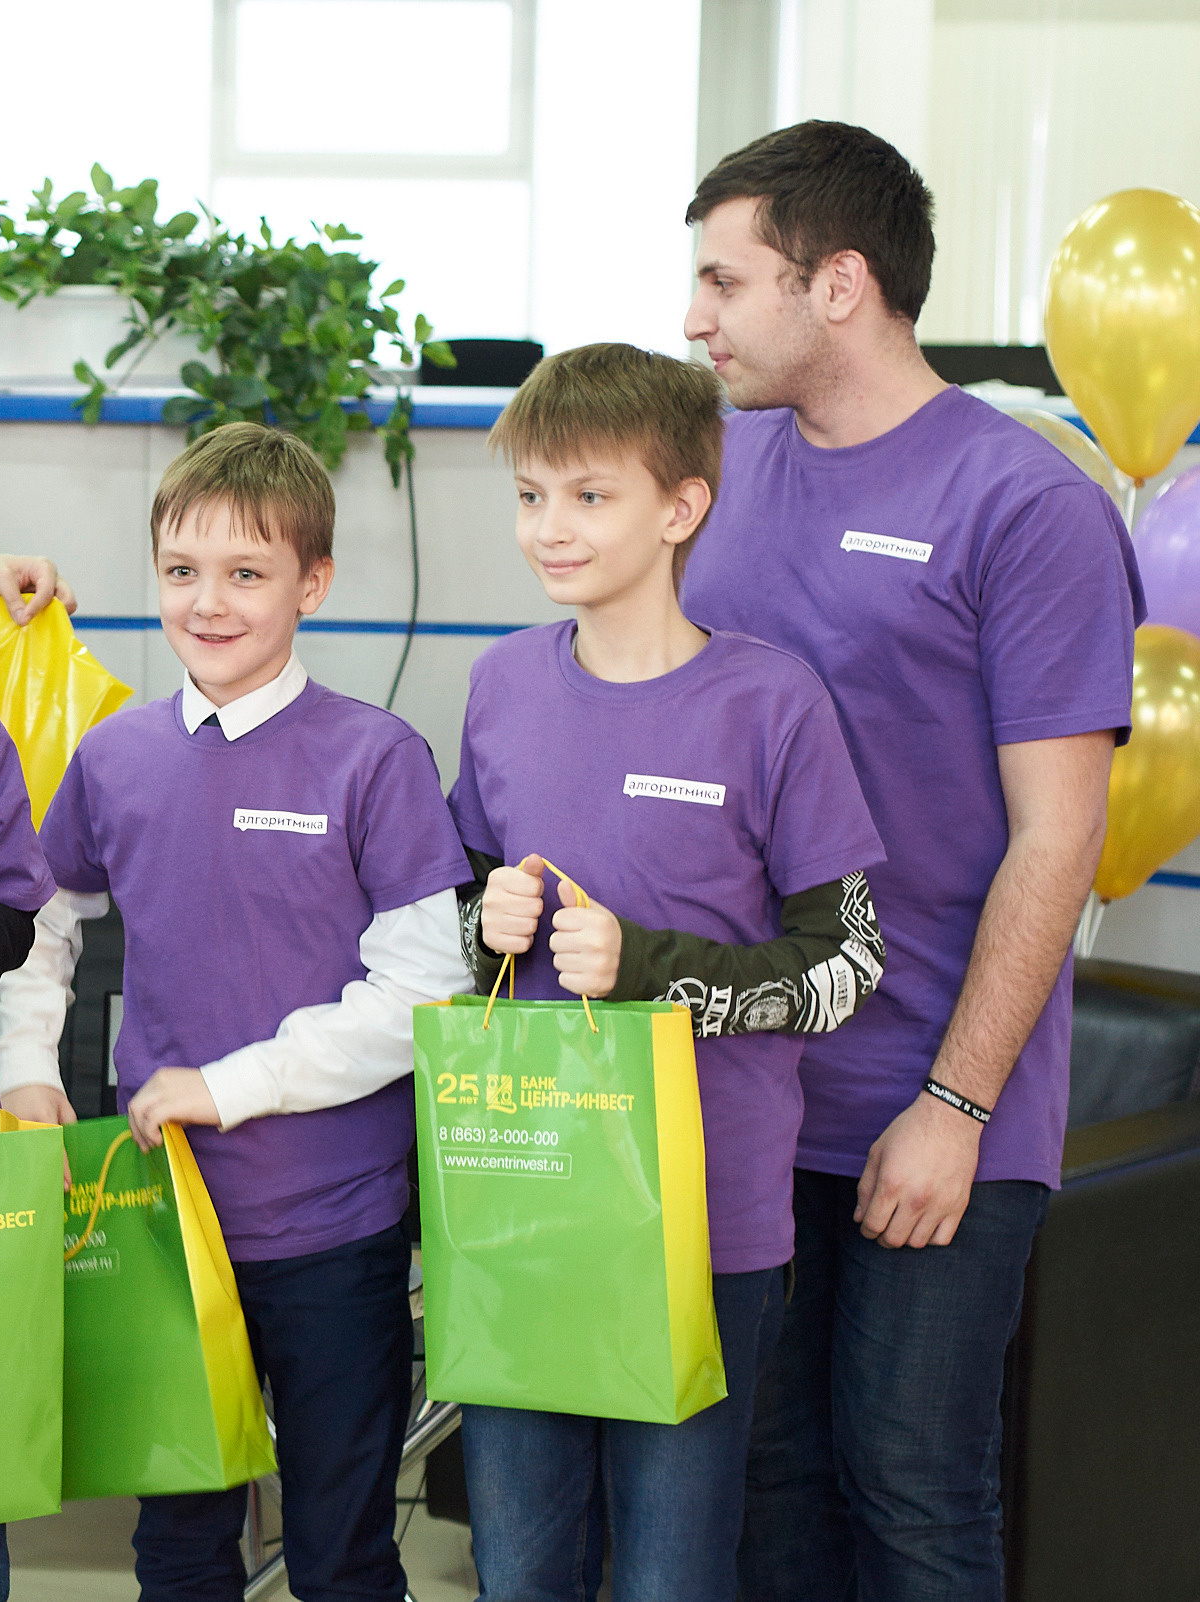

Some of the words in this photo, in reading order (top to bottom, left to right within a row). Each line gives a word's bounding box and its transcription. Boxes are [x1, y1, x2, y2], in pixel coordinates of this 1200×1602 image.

[846, 537, 927, 557] алгоритмика
[628, 781, 720, 800] алгоритмика
[238, 815, 323, 830] алгоритмика
[437, 1072, 479, 1104] 25
[521, 1075, 557, 1090] БАНК
[459, 1096, 478, 1105] лет
[520, 1089, 635, 1111] ЦЕНТР-ИНВЕСТ
[439, 1127, 447, 1141] 8
[451, 1127, 485, 1143] (863)
[489, 1128, 559, 1146] 2-000-000
[444, 1155, 564, 1172] www.centrinvest.ru
